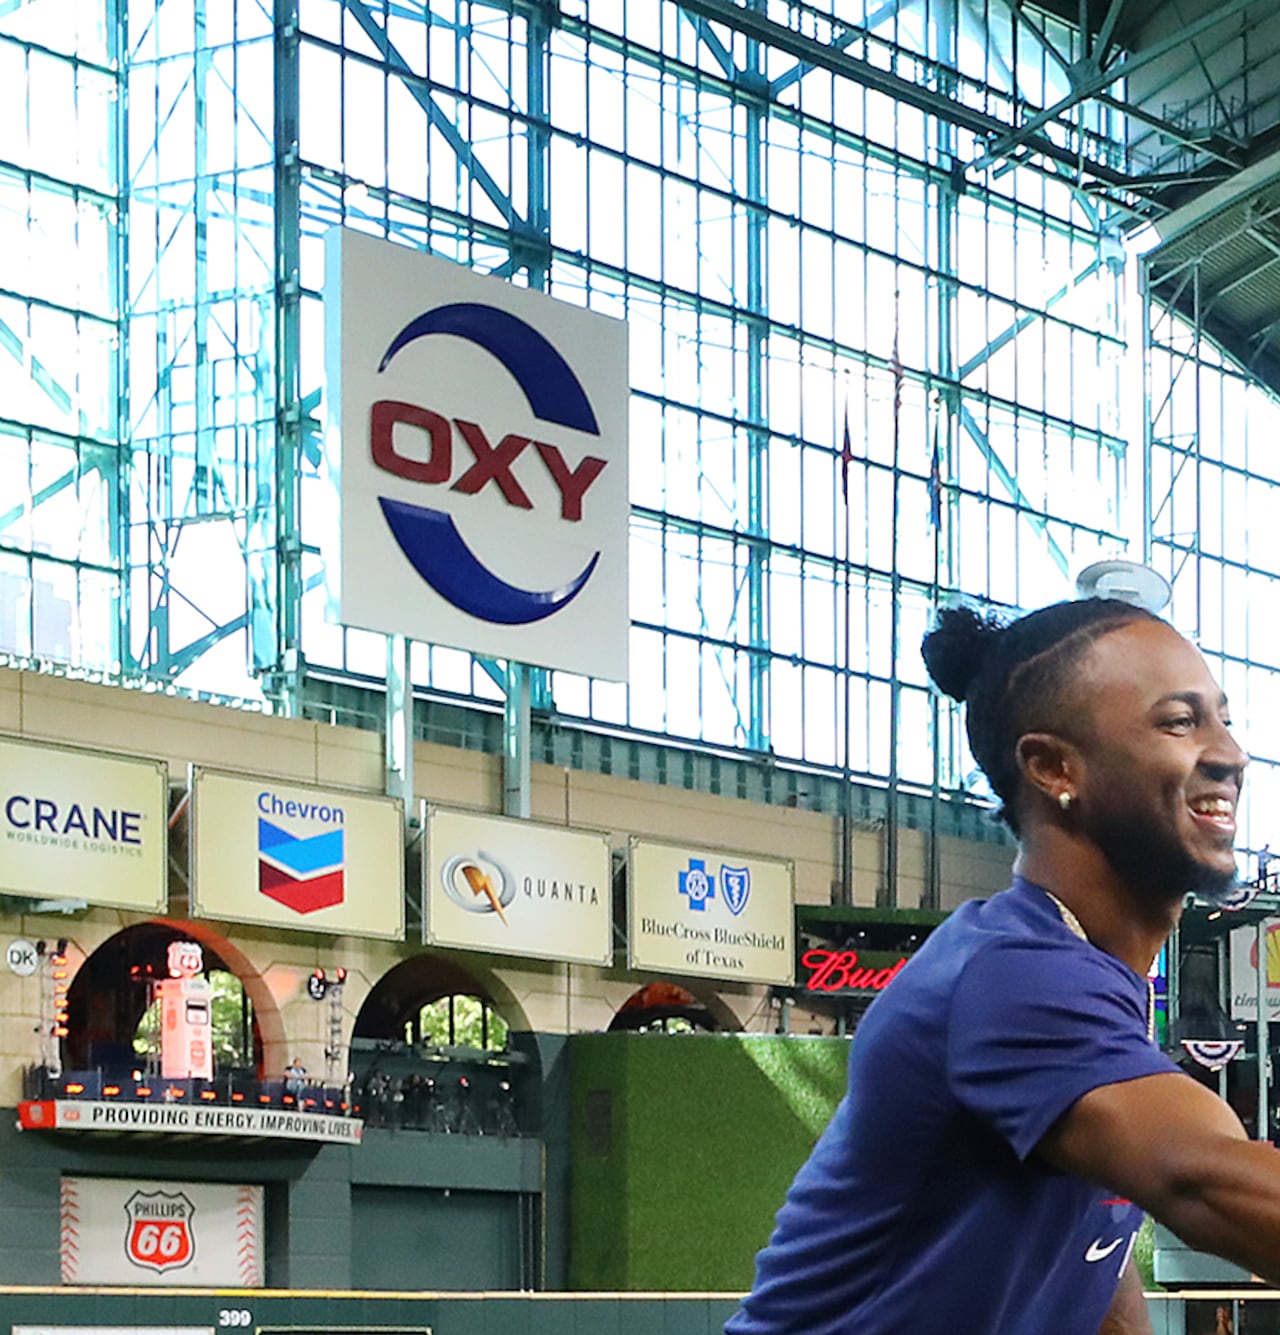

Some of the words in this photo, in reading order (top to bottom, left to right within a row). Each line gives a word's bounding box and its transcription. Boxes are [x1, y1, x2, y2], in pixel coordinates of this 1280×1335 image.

[370, 399, 608, 522] OXY
[5, 795, 141, 844] CRANE
[258, 791, 345, 824] Chevron
[7, 831, 79, 850] WORLDWIDE
[83, 842, 143, 858] LOGISTICS
[523, 876, 599, 905] QUANTA
[641, 917, 712, 942] BlueCross
[713, 928, 785, 951] BlueShield
[10, 952, 34, 966] DK
[686, 949, 701, 967] of
[703, 950, 744, 969] Texas
[801, 949, 907, 992] Bud
[92, 1106, 189, 1127] PROVIDING
[260, 1116, 326, 1134] IMPROVING
[134, 1202, 187, 1218] PHILLIPS
[136, 1225, 183, 1255] 66
[219, 1310, 251, 1326] 399
